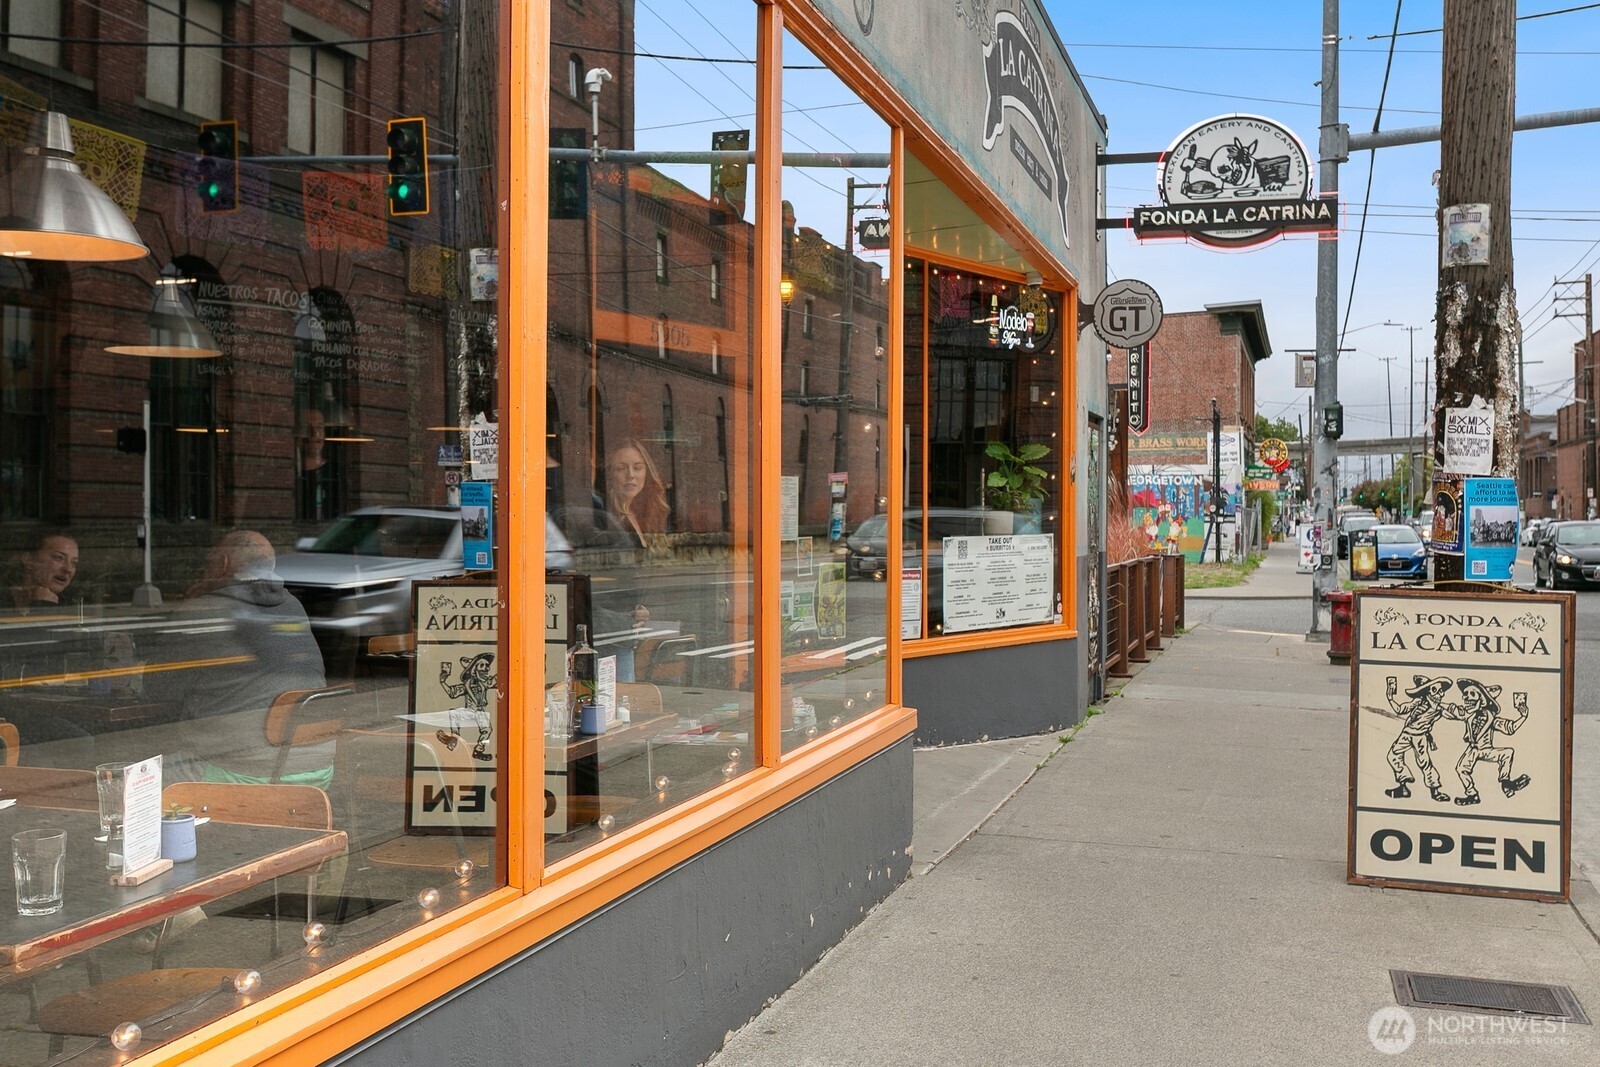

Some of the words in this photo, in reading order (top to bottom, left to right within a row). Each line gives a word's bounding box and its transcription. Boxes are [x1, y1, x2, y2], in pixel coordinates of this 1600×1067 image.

[998, 38, 1016, 77] LA
[1018, 49, 1060, 164] CATRINA
[1167, 136, 1195, 184] MEXICAN
[1198, 121, 1243, 137] EATERY
[1246, 121, 1271, 133] AND
[1274, 131, 1304, 177] CANTINA
[1139, 208, 1209, 227] FONDA
[1212, 207, 1239, 224] LA
[1243, 202, 1331, 221] CATRINA
[198, 281, 259, 300] NUESTROS
[998, 308, 1028, 332] Modelo
[1109, 305, 1147, 332] GT
[1130, 348, 1141, 426] RENITO
[1447, 424, 1491, 436] SOCIALS
[1449, 415, 1467, 425] MIX
[1468, 416, 1489, 426] MIX
[1138, 437, 1172, 448] BRASS
[1176, 436, 1207, 447] WORK
[1246, 479, 1278, 490] AVERN
[988, 537, 1002, 545] TAKE
[1003, 536, 1013, 544] OUT
[1415, 613, 1503, 628] FONDA
[1370, 631, 1408, 650] LA
[1415, 633, 1551, 656] CATRINA
[1370, 828, 1546, 874] OPEN
